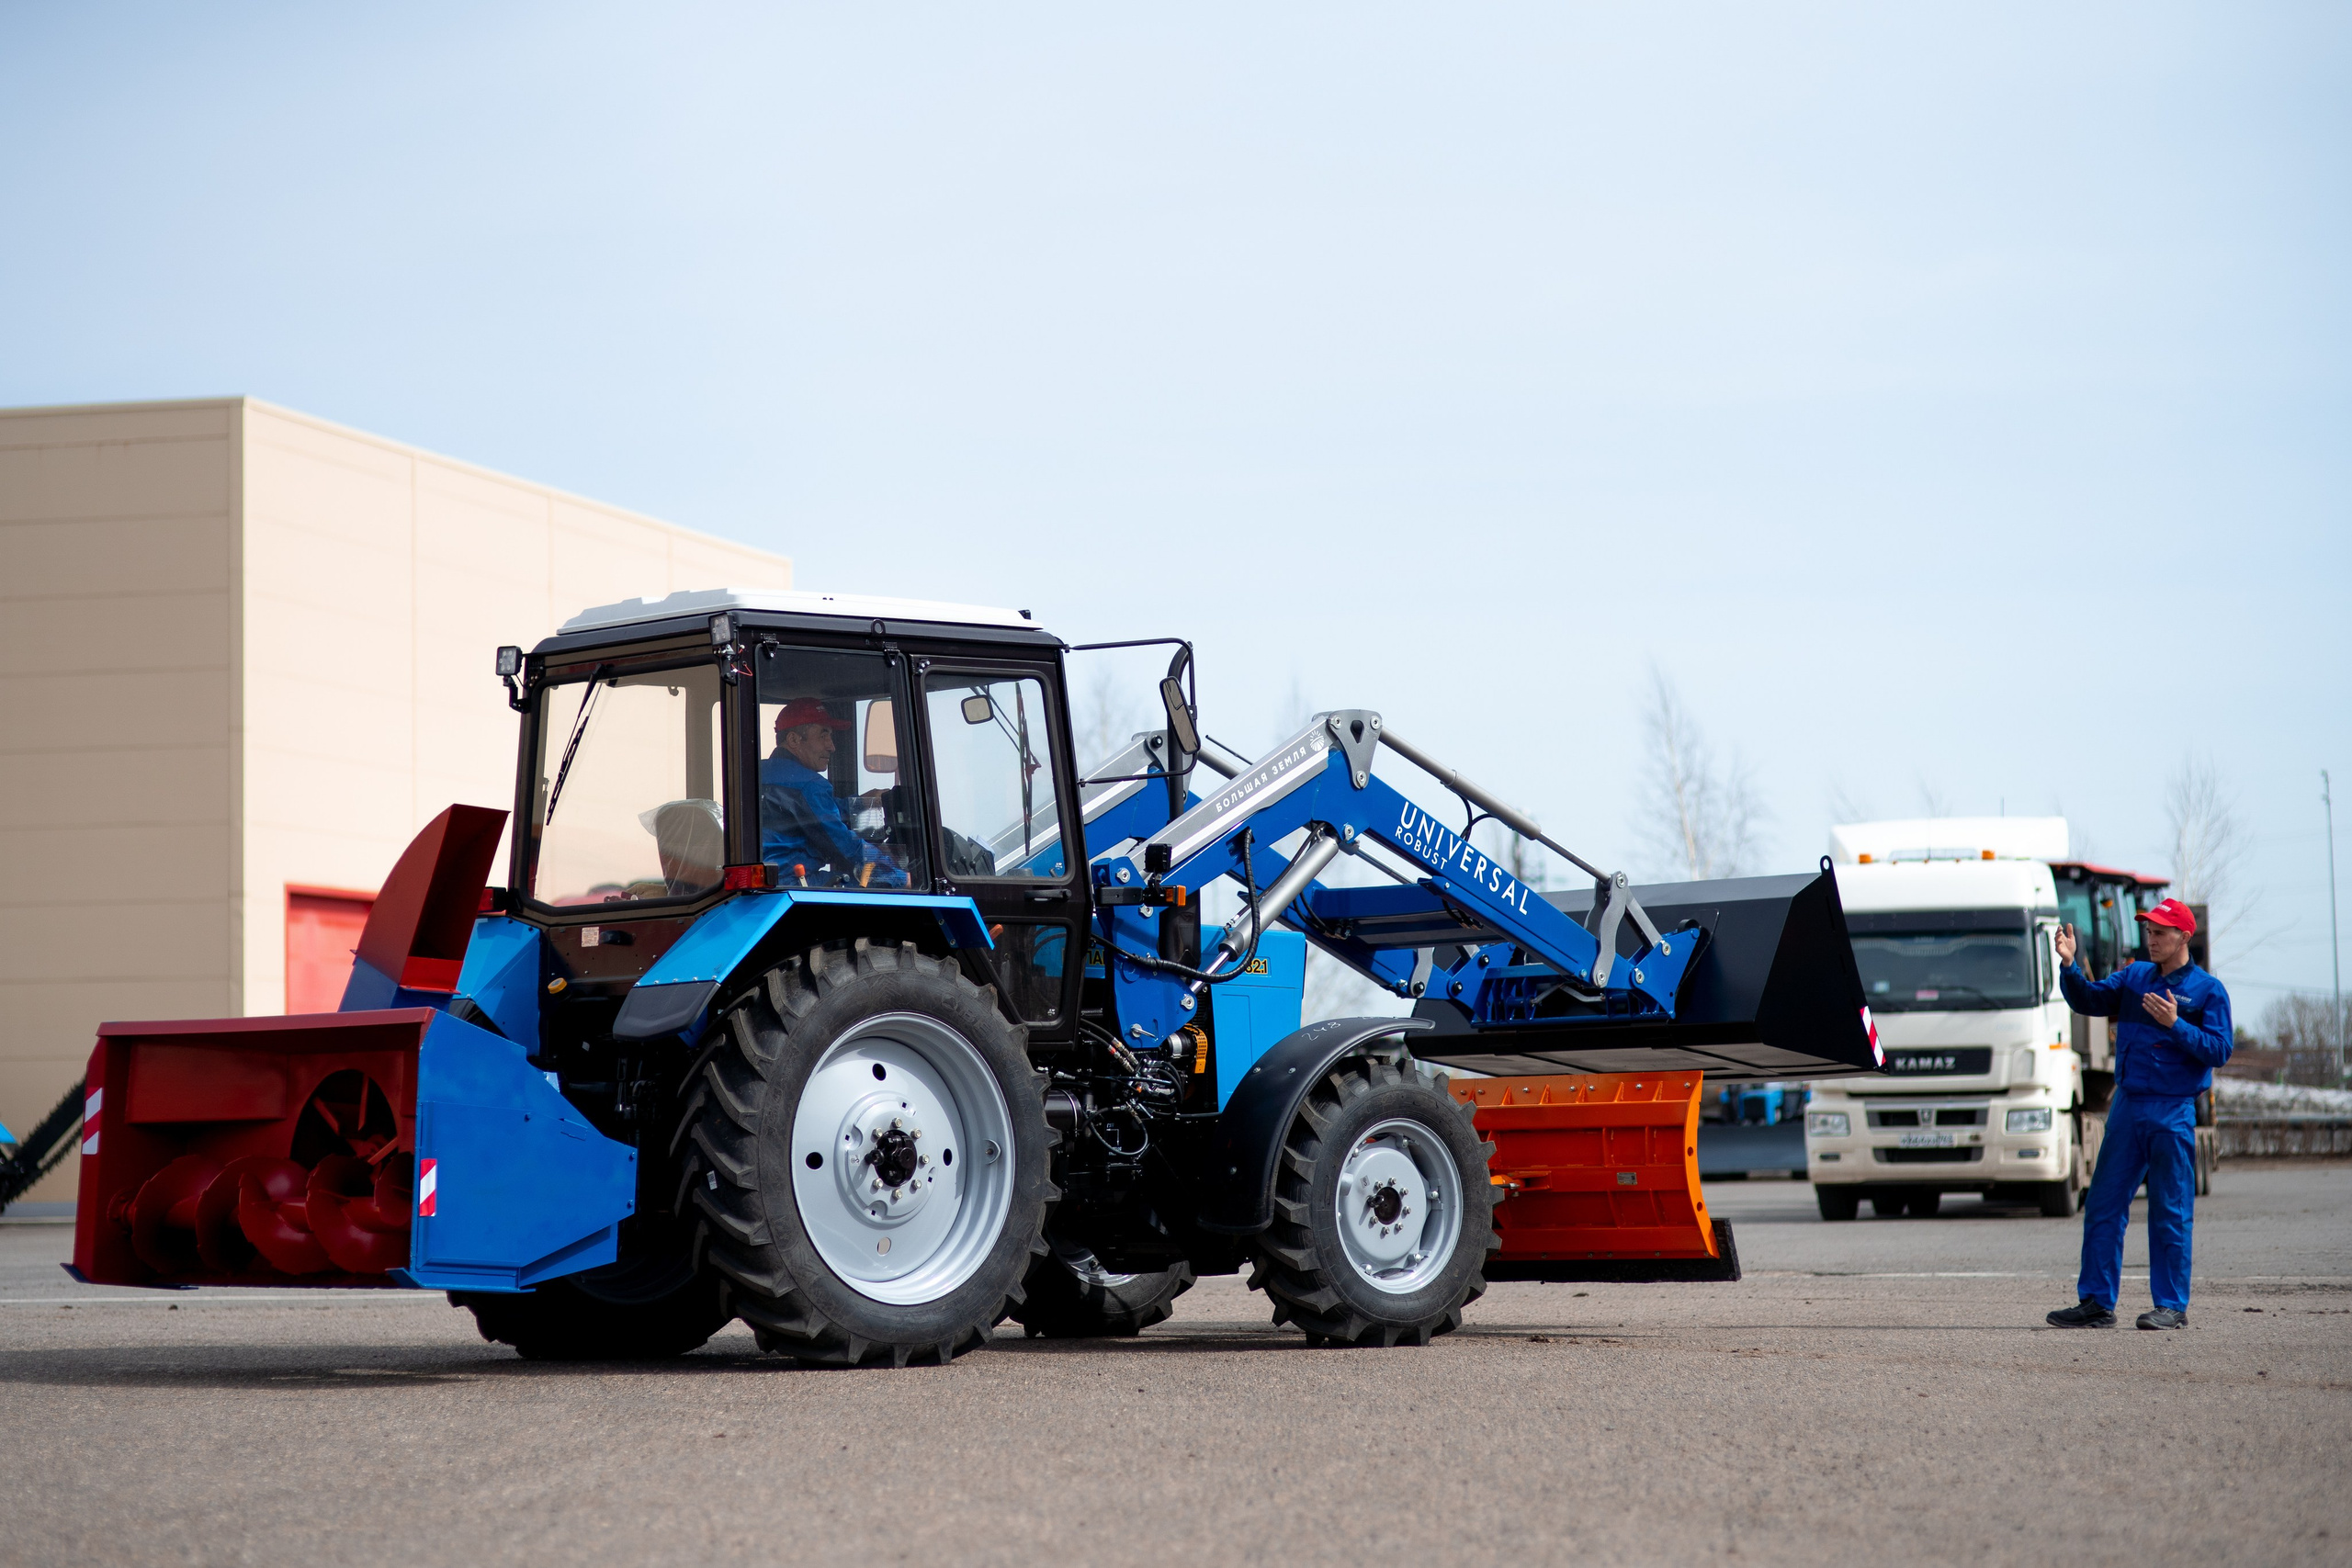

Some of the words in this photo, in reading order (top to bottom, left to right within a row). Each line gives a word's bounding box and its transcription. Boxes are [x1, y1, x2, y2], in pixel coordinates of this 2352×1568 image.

[1216, 773, 1268, 813] БОЛЬШАЯ
[1272, 746, 1306, 775] ЗЕМЛЯ
[1395, 825, 1448, 870] ROBUST
[1400, 801, 1529, 916] UNIVERSAL
[1894, 1056, 1956, 1071] KAMAZ
